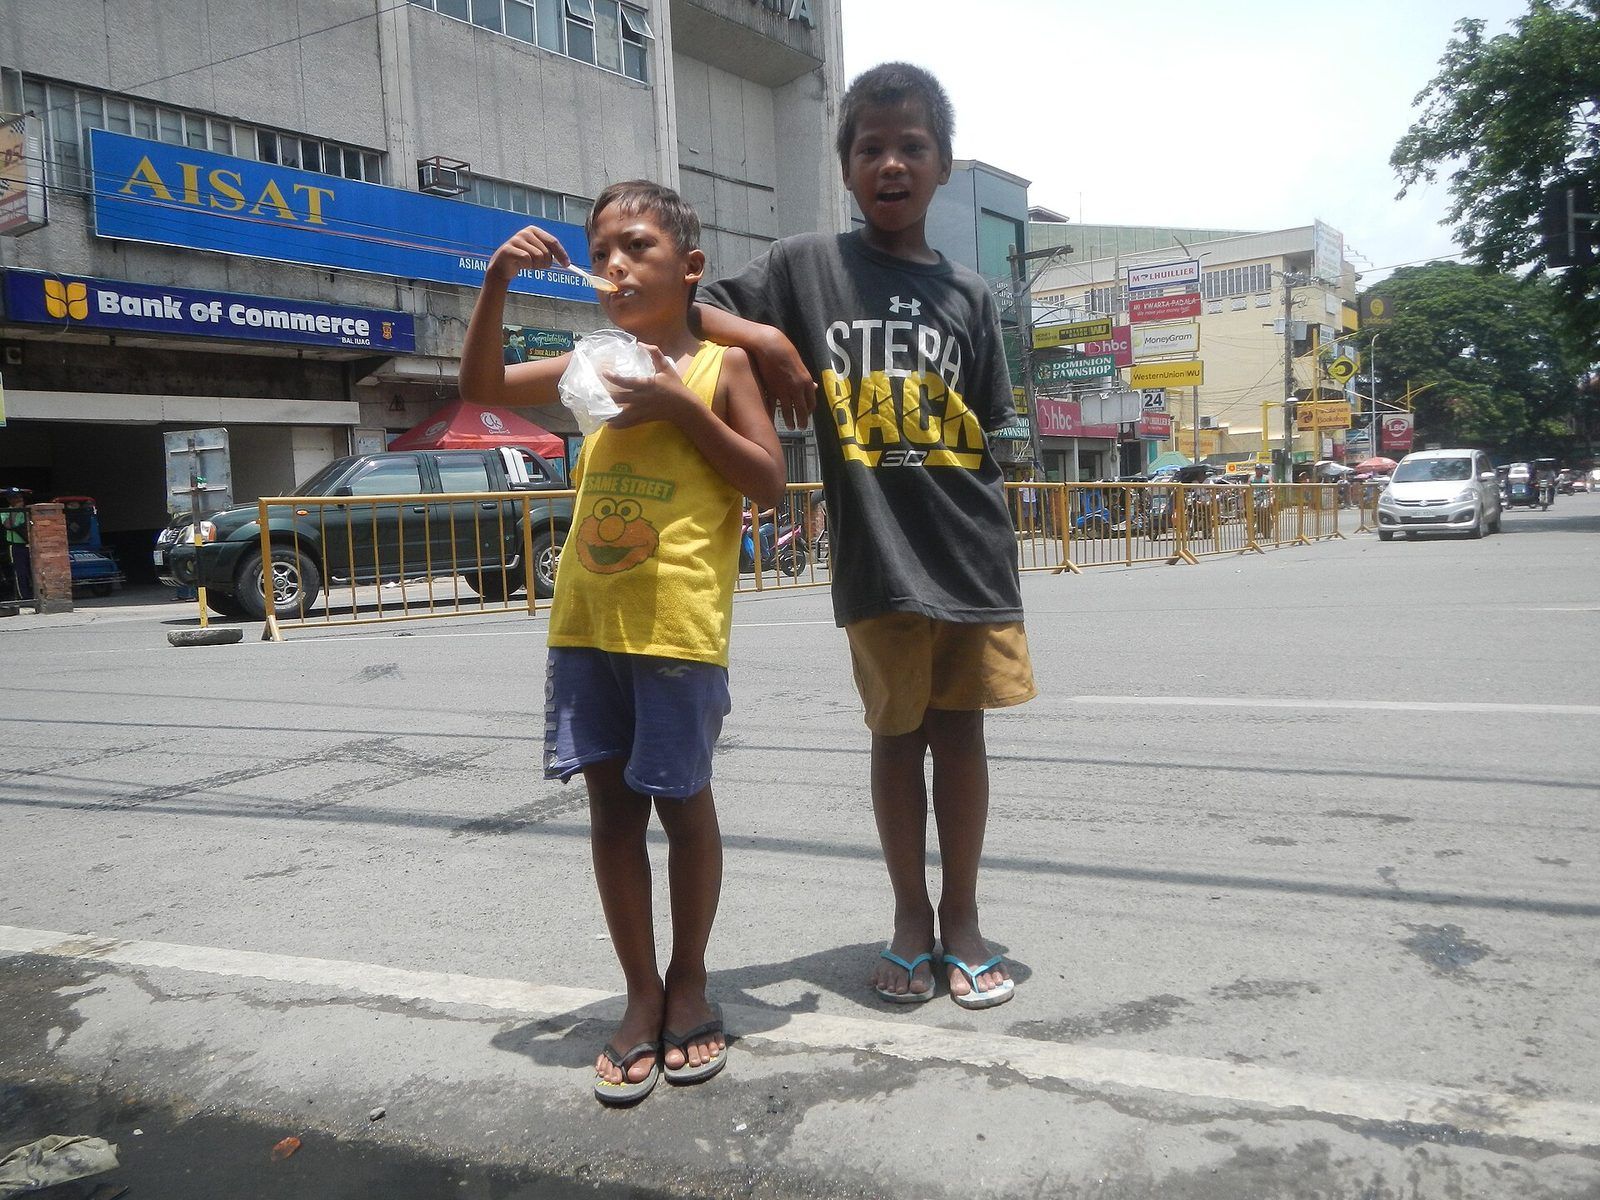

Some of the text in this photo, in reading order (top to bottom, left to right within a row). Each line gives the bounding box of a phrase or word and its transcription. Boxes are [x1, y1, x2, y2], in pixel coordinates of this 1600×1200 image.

[118, 155, 334, 225] AISAT
[459, 257, 486, 271] ASIAN
[535, 269, 545, 280] OF
[547, 271, 580, 286] SCIENCE
[1149, 267, 1194, 280] LHUILLIER
[97, 290, 370, 337] Bank of Commerce
[1102, 339, 1128, 352] hbc
[1144, 333, 1192, 344] MoneyGram
[825, 319, 962, 391] STEPH
[1053, 357, 1111, 370] DOMINION
[1053, 365, 1111, 379] PAWNSHOP
[1133, 370, 1184, 380] WesternUnion
[1144, 393, 1163, 408] 24
[1051, 405, 1072, 430] hbc
[1000, 427, 1030, 438] AWNSHO
[1389, 423, 1405, 431] LBC
[621, 477, 672, 499] STREET
